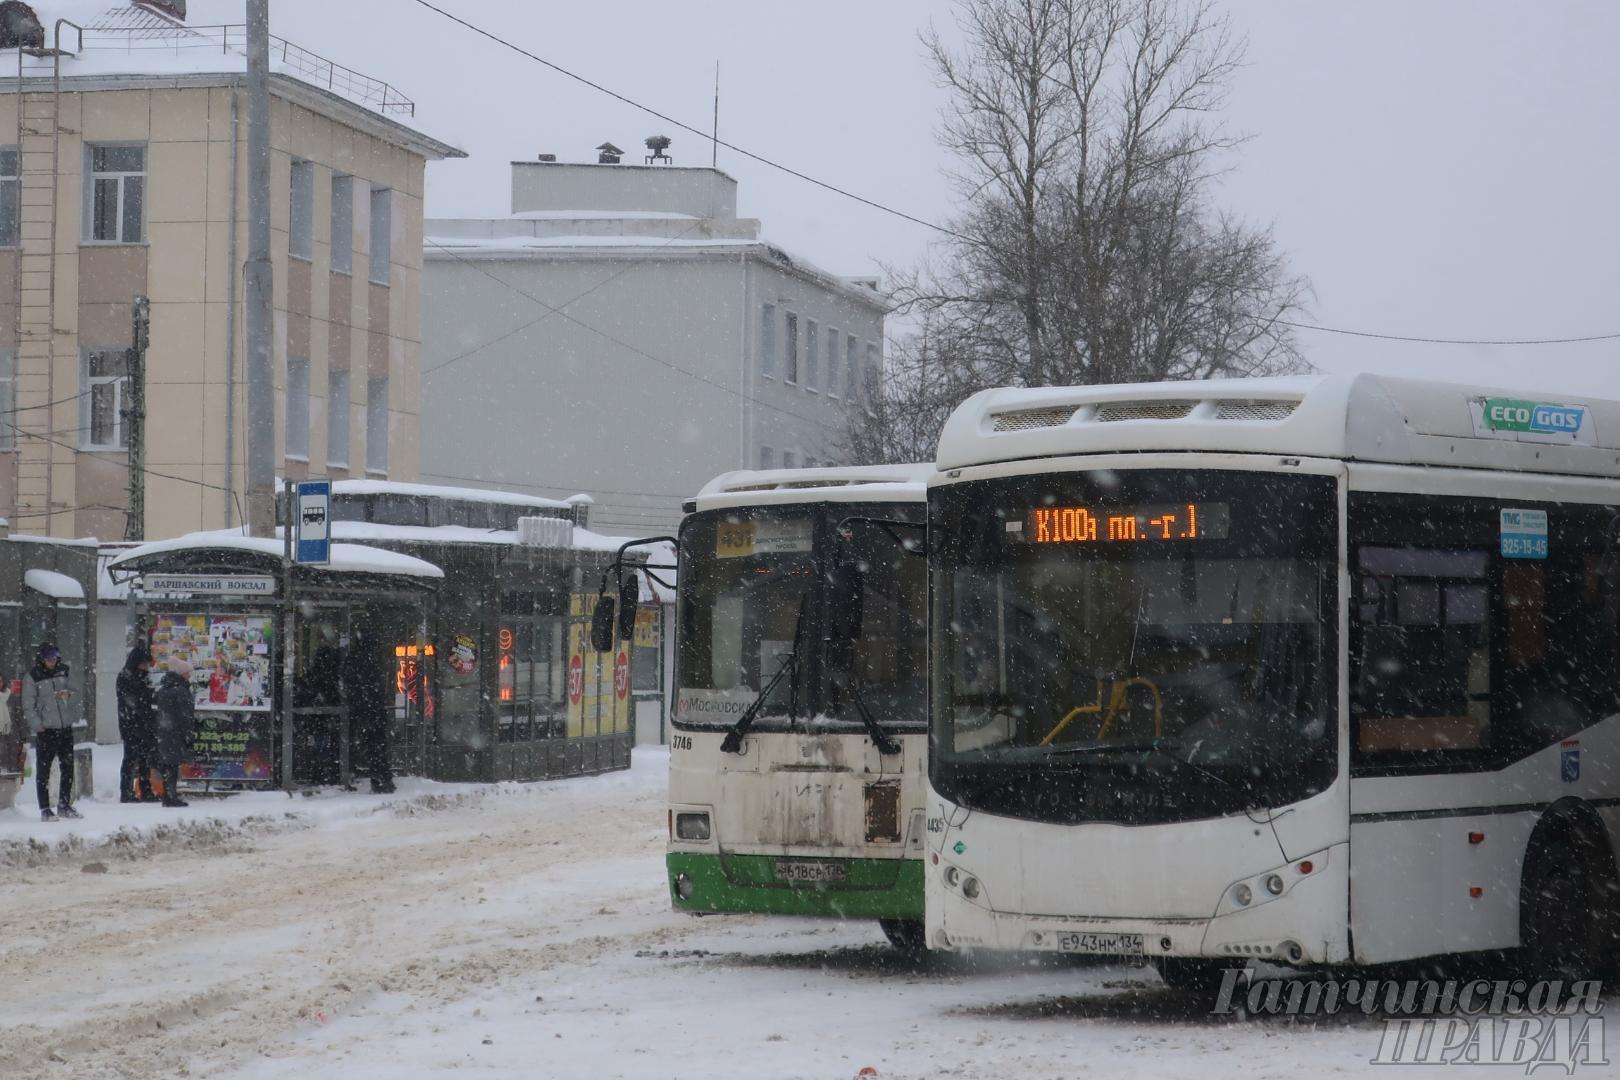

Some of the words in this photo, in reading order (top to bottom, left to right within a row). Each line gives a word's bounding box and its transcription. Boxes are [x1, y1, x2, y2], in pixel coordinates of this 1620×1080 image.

[1490, 406, 1530, 423] ECO
[1503, 538, 1546, 554] 325-15-45
[153, 579, 221, 590] ВАРШАВСКИЙ
[227, 580, 267, 591] ВОКЗАЛ
[689, 698, 753, 714] Московска
[672, 735, 692, 751] 3746
[1120, 935, 1142, 949] 134
